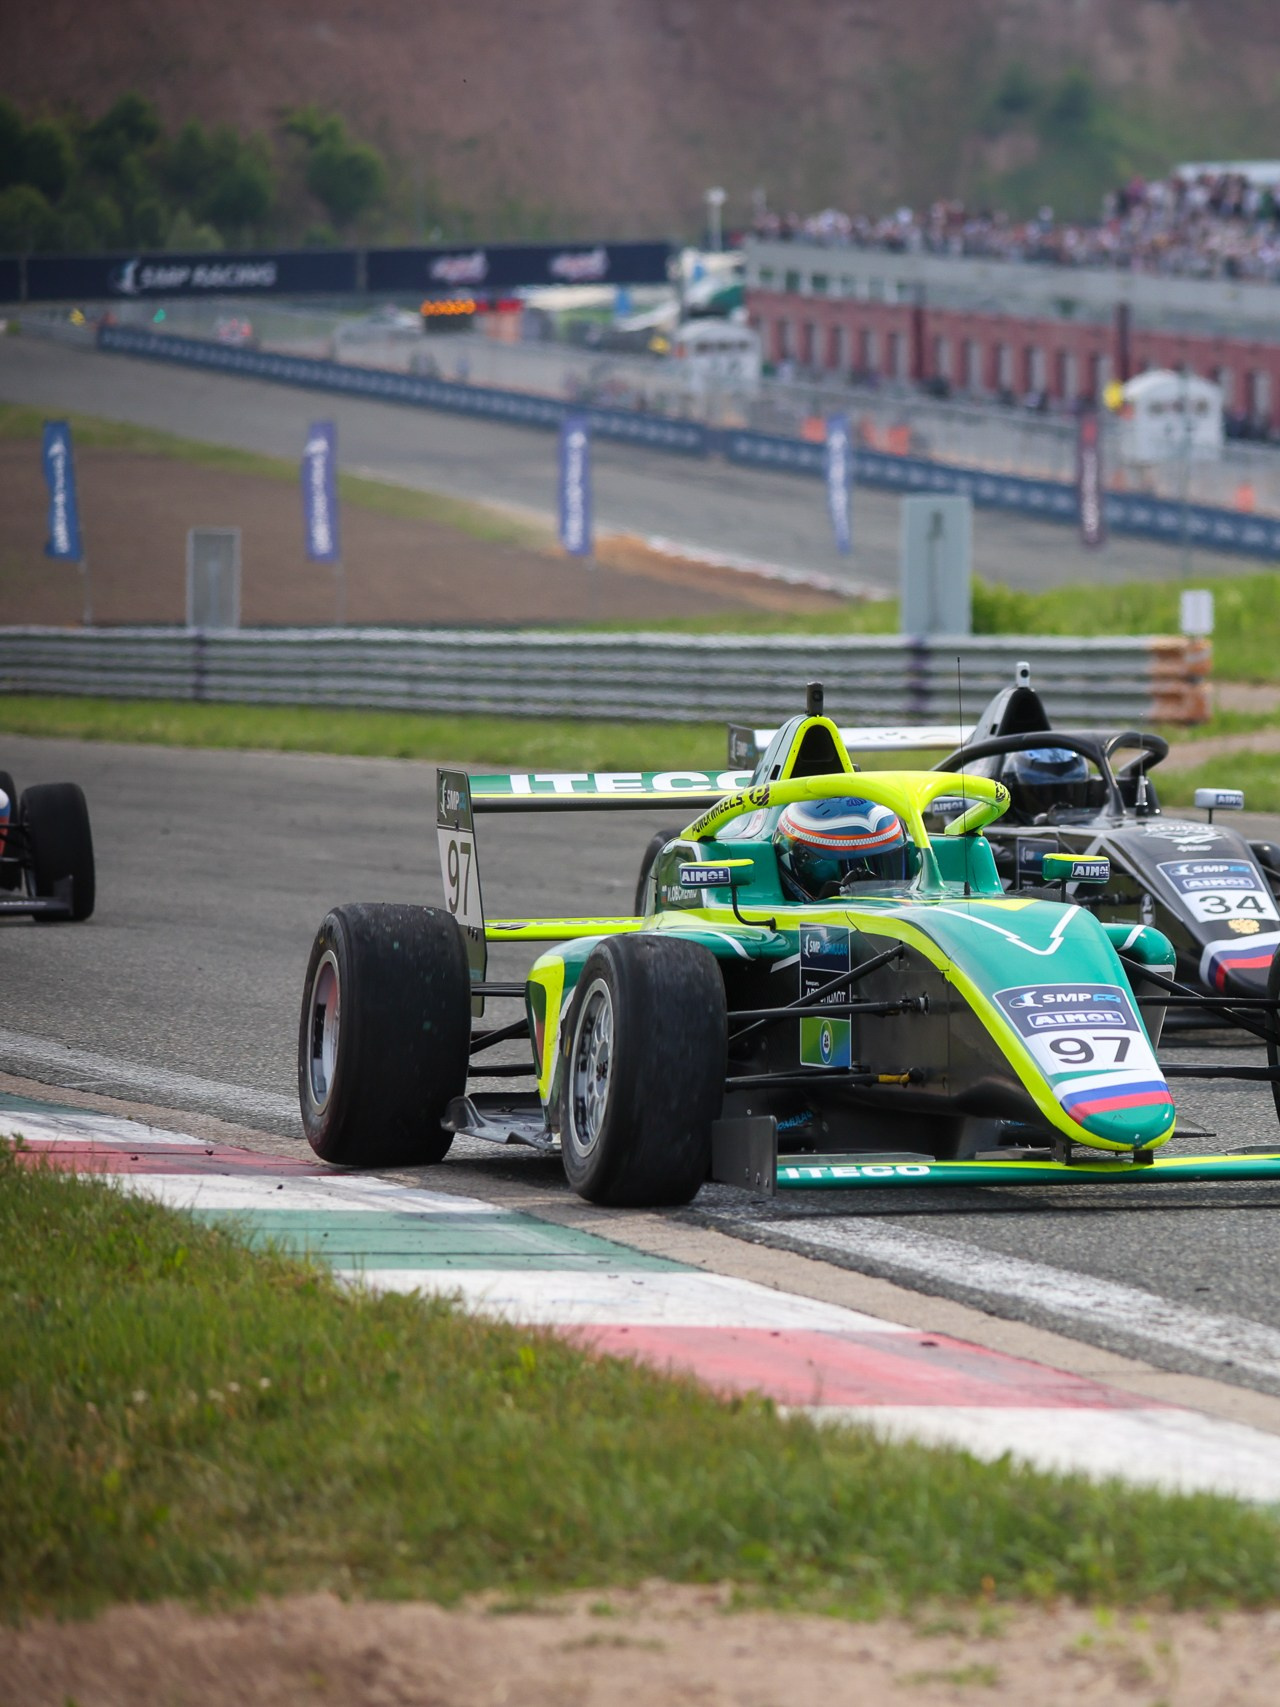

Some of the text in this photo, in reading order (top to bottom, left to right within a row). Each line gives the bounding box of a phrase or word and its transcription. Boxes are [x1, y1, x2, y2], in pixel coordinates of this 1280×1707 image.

[448, 839, 472, 915] 97
[681, 870, 728, 882] AIMOL
[1187, 879, 1249, 888] AIMOL
[1198, 895, 1267, 915] 34
[1035, 1013, 1121, 1026] AIMOL
[1049, 1037, 1131, 1065] 97
[785, 1165, 931, 1179] ITECO
